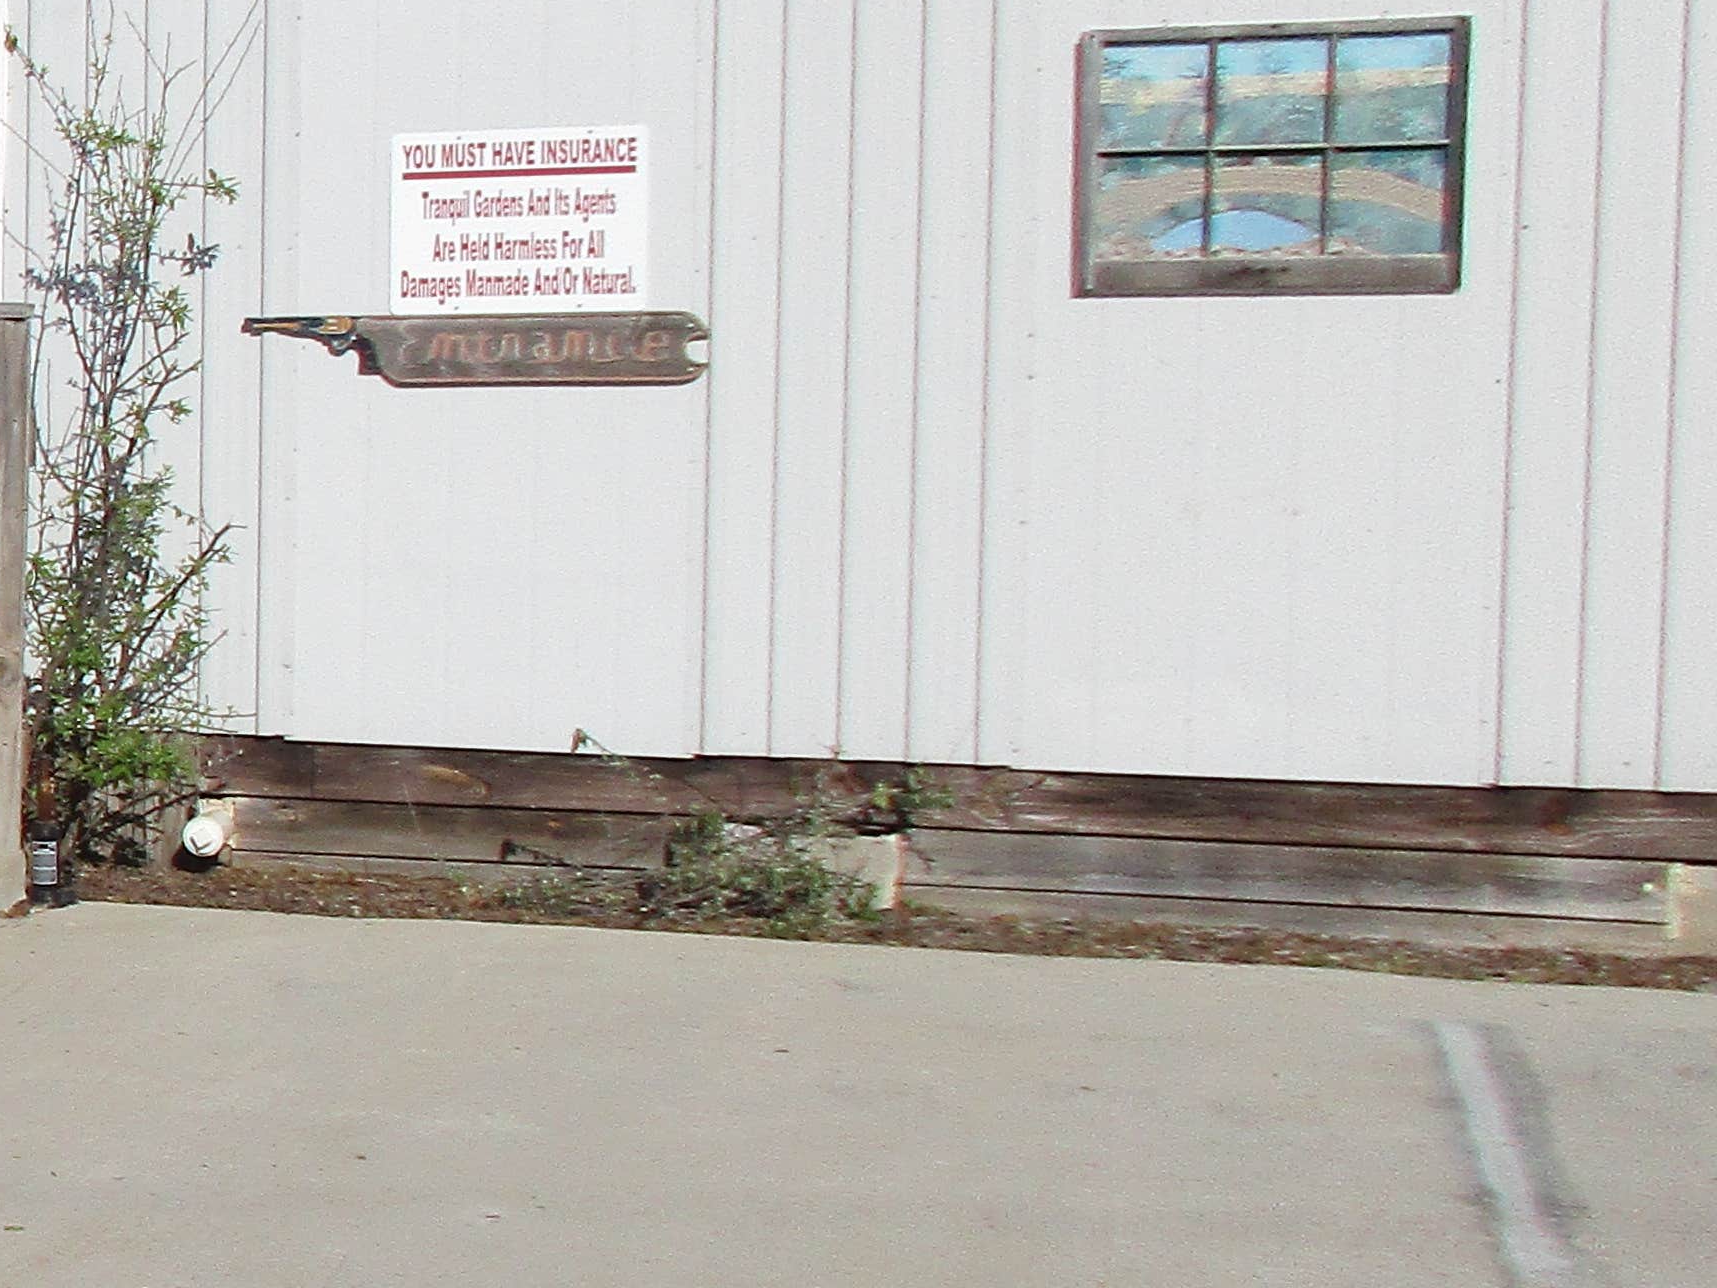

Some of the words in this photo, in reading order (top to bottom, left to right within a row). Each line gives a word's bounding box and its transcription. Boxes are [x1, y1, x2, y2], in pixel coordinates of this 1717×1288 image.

[402, 144, 435, 169] YOU
[441, 142, 486, 168] MUST
[492, 140, 535, 166] HAVE
[540, 137, 638, 165] INSURANCE
[421, 190, 470, 226] Tranquil
[473, 189, 524, 218] Gardens
[526, 188, 550, 217] And
[554, 187, 570, 215] Its
[573, 187, 617, 222] Agents
[432, 234, 455, 262] Are
[460, 233, 490, 261] Held
[494, 232, 557, 261] Harmless
[561, 230, 584, 259] For
[587, 230, 605, 258] All
[400, 270, 461, 305] Damages
[465, 268, 529, 297] Manmade
